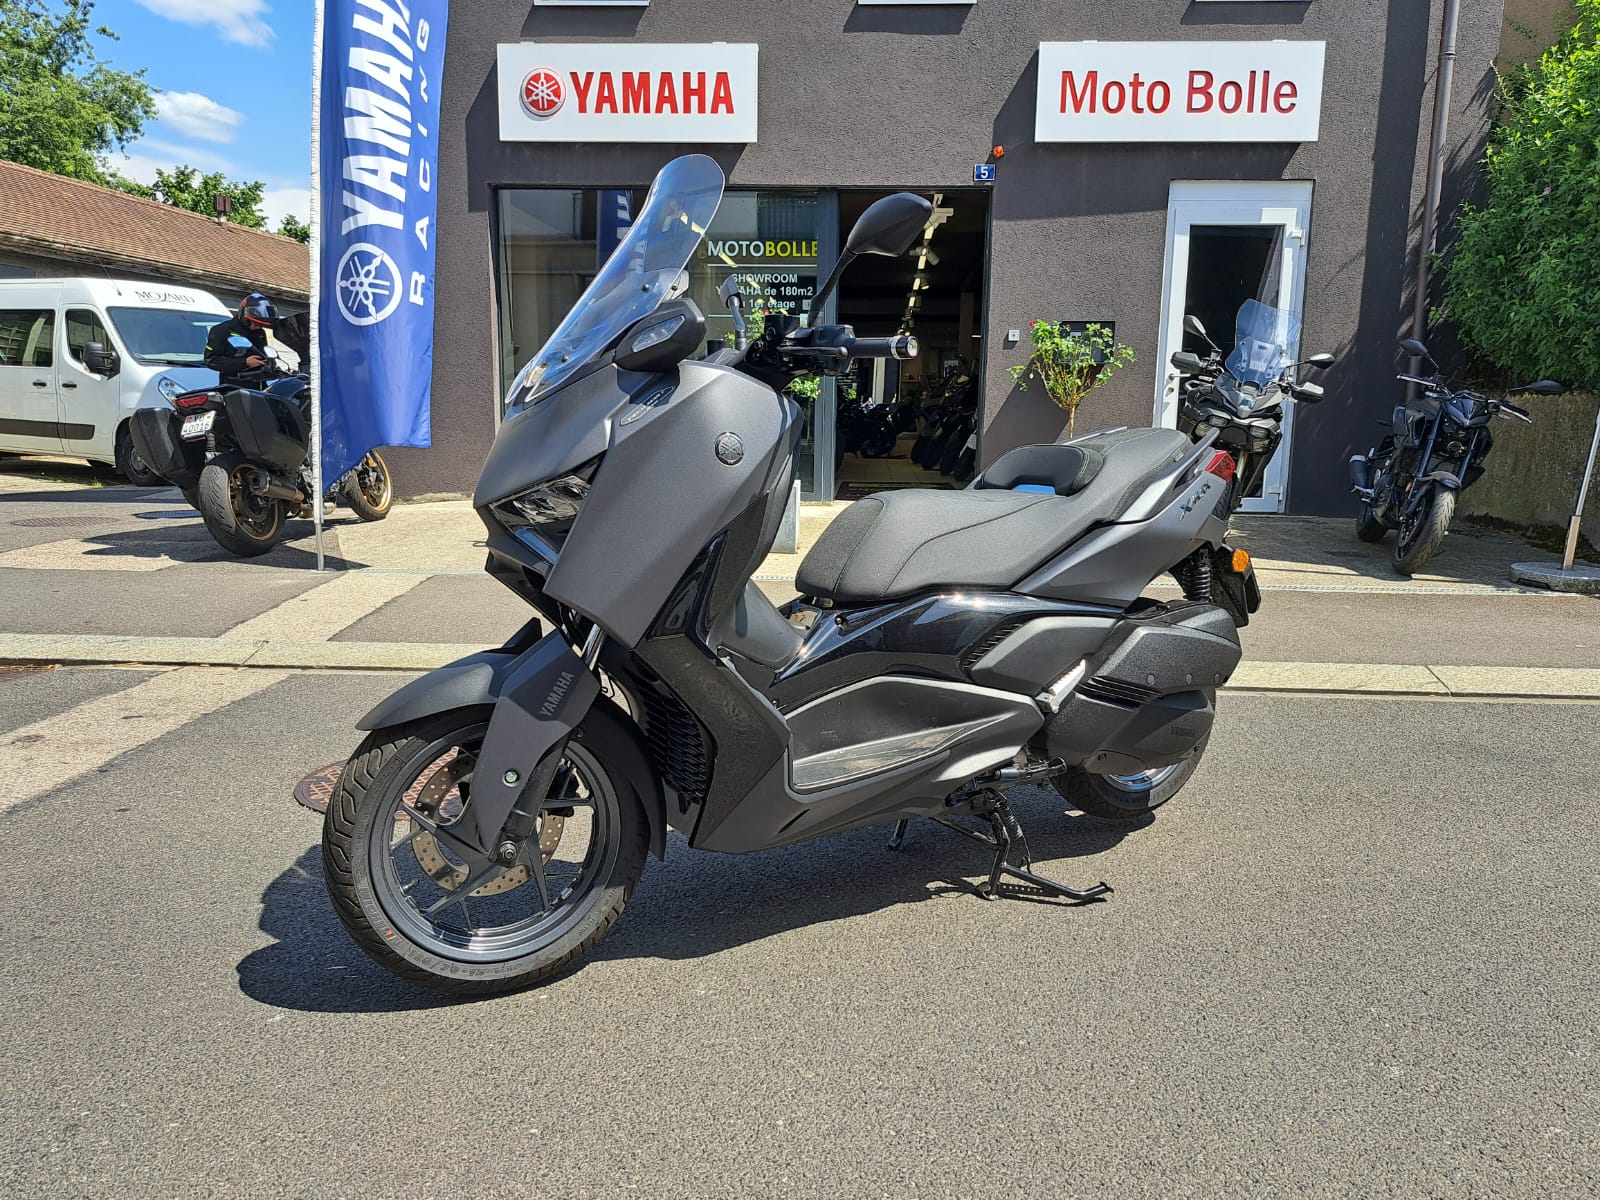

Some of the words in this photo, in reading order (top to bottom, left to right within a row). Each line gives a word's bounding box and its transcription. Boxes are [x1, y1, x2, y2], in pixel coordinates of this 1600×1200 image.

[569, 71, 735, 114] YAMAHA
[1059, 70, 1171, 114] Moto
[1186, 70, 1298, 114] Bolle
[341, 0, 414, 236] YAMAH
[409, 18, 430, 306] RACING
[980, 166, 989, 179] 5
[732, 273, 798, 284] SHOWROOM
[764, 286, 777, 296] de
[780, 286, 814, 296] 180m2
[539, 671, 575, 717] YAMAHA
